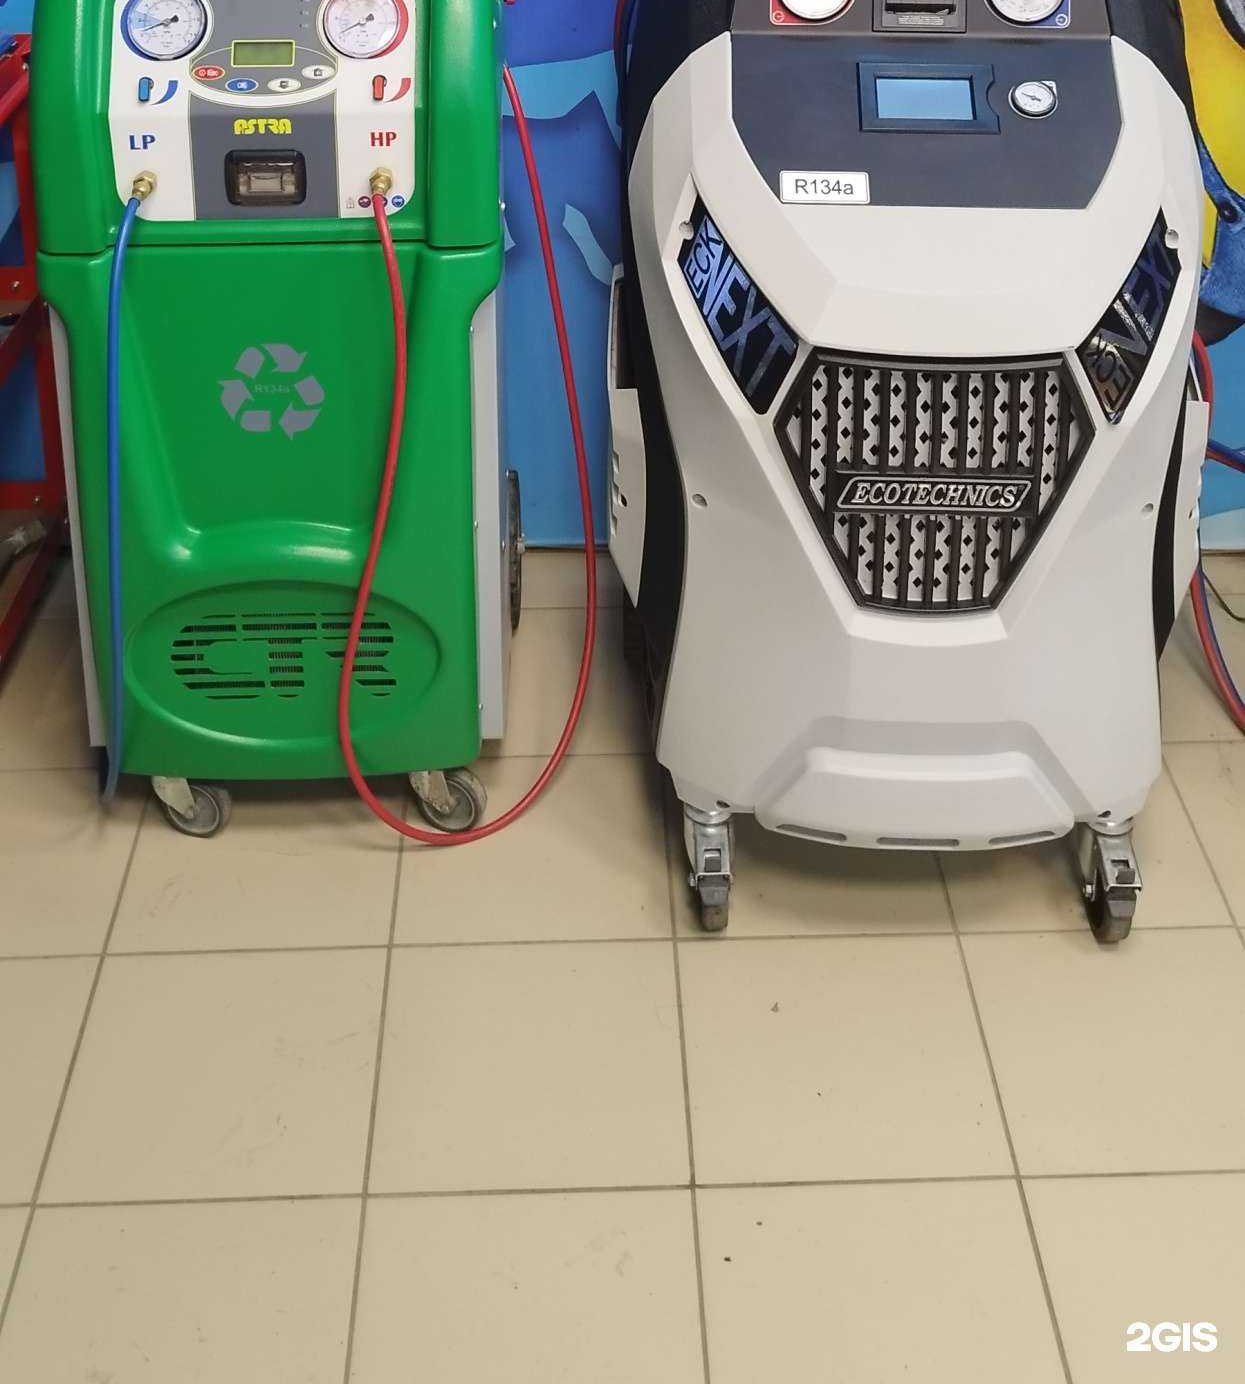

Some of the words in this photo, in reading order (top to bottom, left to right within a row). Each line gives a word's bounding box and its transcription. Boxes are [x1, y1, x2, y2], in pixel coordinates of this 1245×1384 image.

[233, 118, 292, 135] ASTRA
[129, 134, 156, 150] LP
[370, 131, 398, 146] HP
[795, 178, 854, 195] R134a
[686, 219, 722, 294] ECK
[702, 250, 797, 398] NEXT
[850, 482, 1018, 507] ECOTECHNICS
